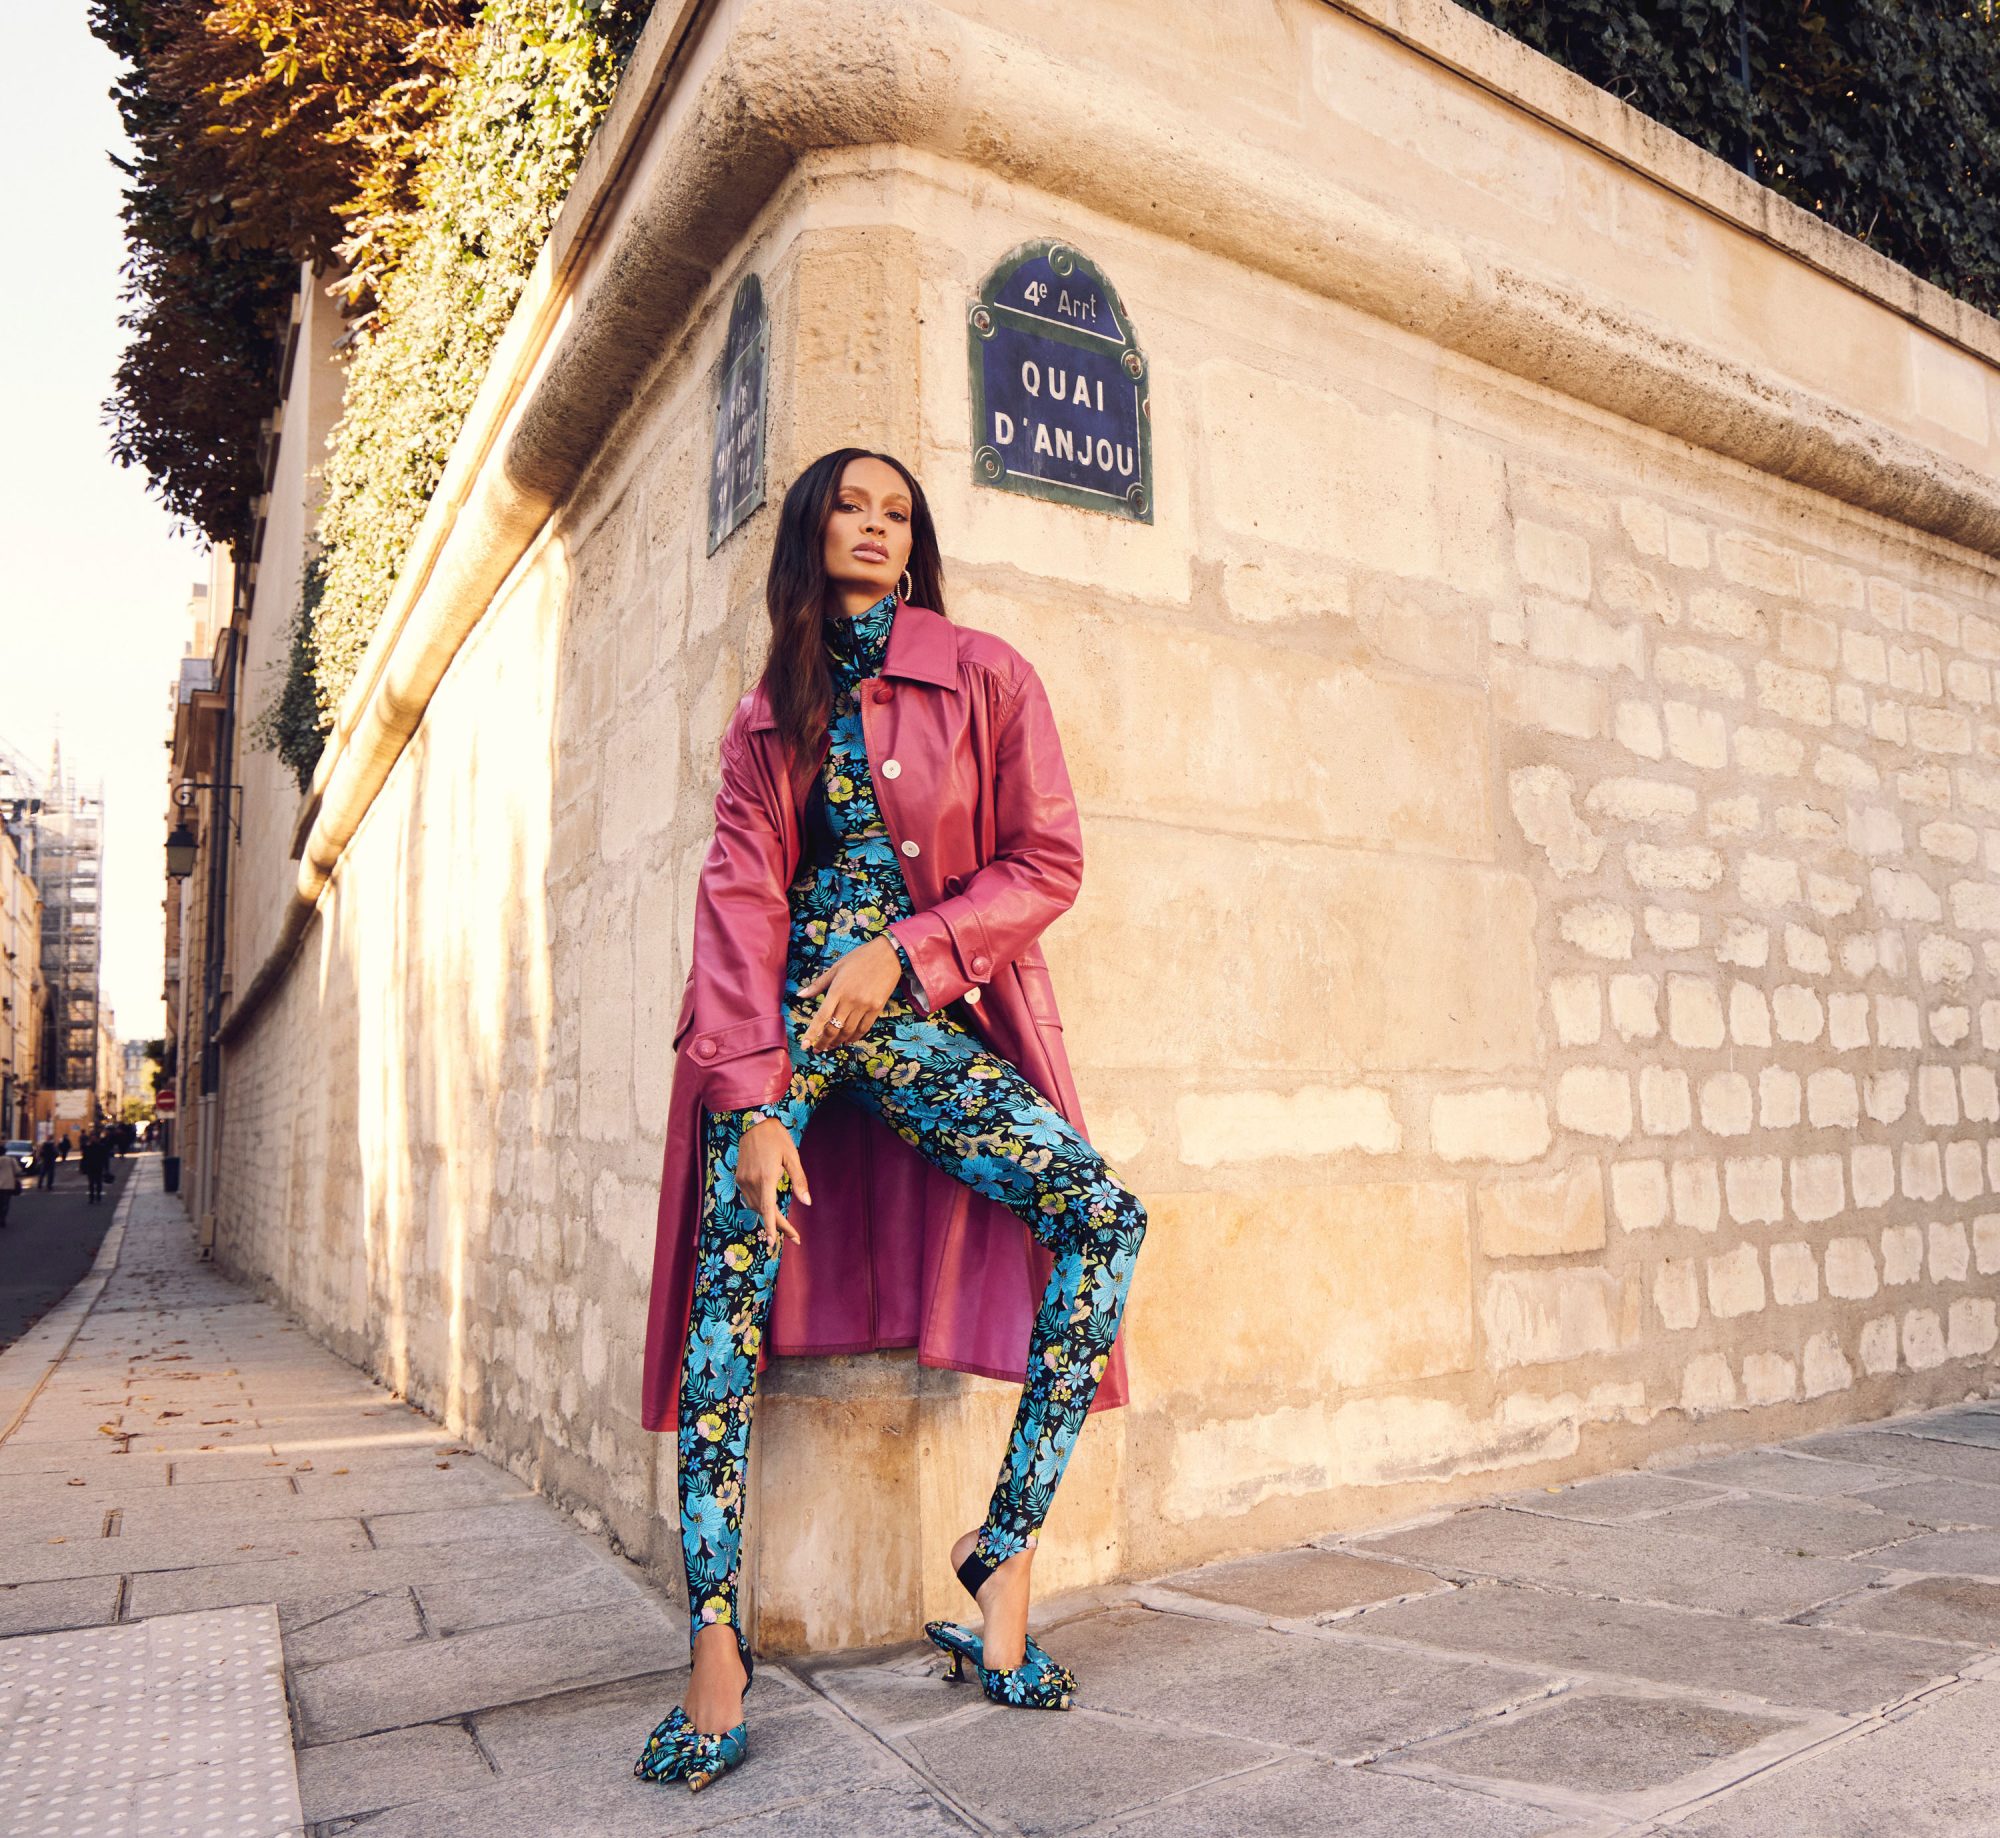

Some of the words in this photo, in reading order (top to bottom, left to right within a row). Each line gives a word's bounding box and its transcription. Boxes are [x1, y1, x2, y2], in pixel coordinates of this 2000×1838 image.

[1024, 280, 1048, 306] 4e
[1021, 360, 1104, 412] QUAI
[737, 408, 759, 454] LOUIS
[994, 411, 1133, 476] D'ANJOU
